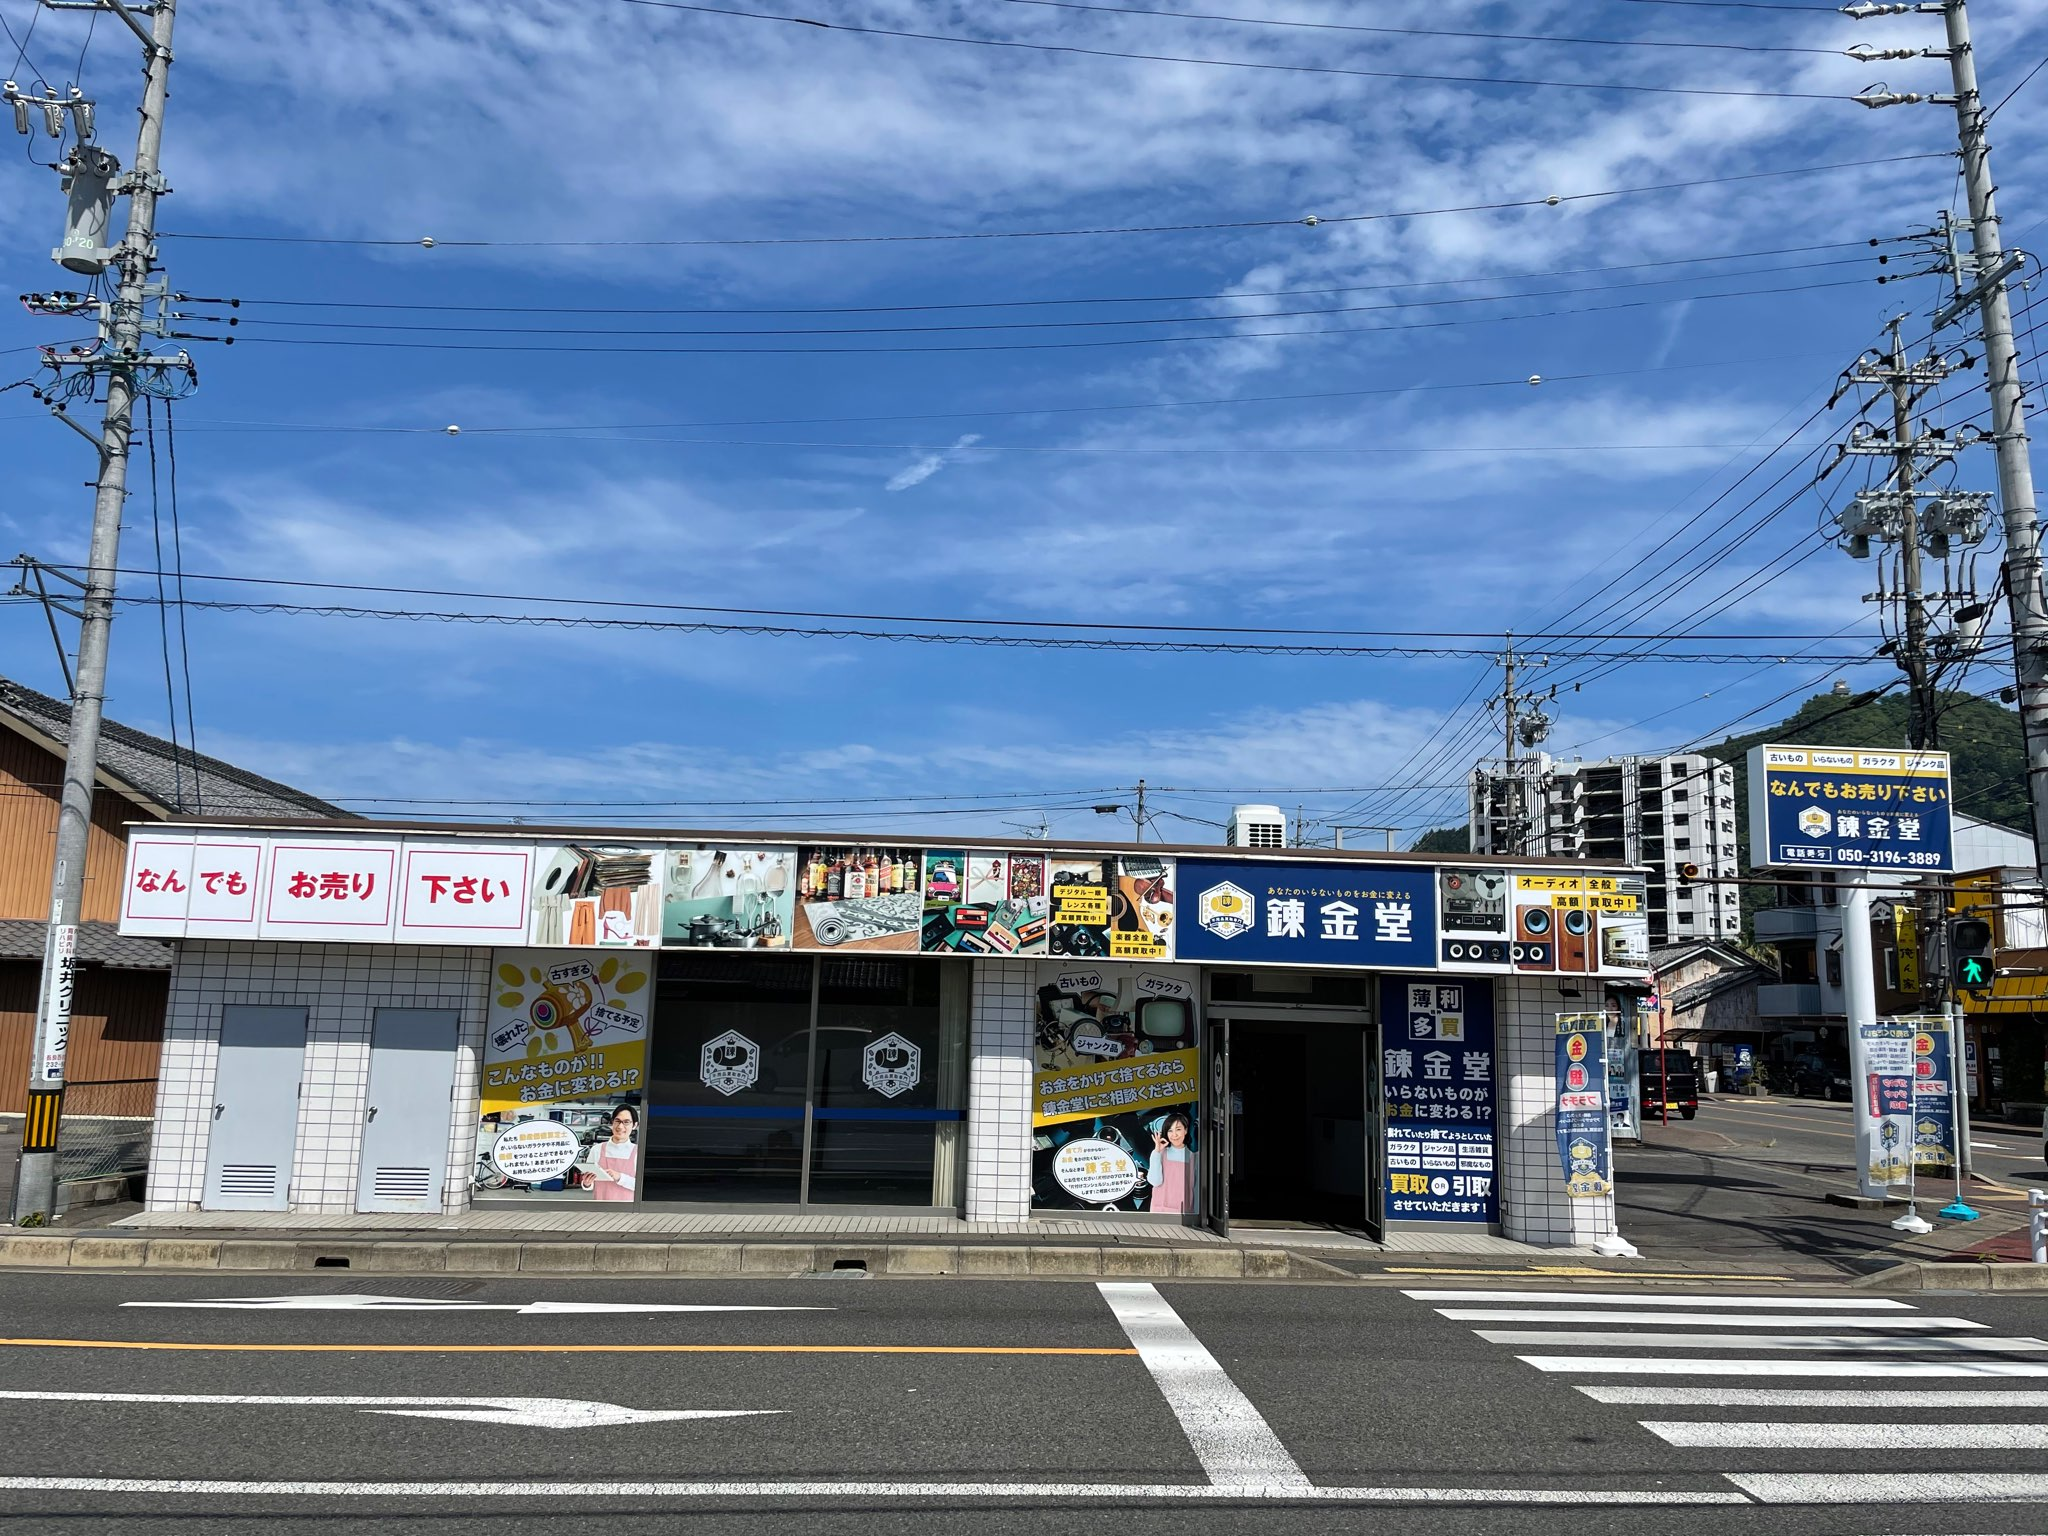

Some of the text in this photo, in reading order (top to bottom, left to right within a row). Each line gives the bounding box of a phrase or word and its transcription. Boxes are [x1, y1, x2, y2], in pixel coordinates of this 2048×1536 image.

[1770, 754, 1945, 769] 古いもの いらないもの ガラクタ ジャンク品
[1770, 780, 1946, 803] なんでもお売り下さい
[1838, 849, 1941, 866] 050-3196-3889
[288, 871, 375, 900] お売り
[421, 875, 510, 904] 下さい
[1059, 888, 1102, 897] デジタル一眼
[1267, 887, 1411, 900] あなたのいらないものをお金に変える
[1067, 902, 1101, 910] レンズ各種
[1061, 914, 1101, 922] 高額買取中!
[1115, 933, 1149, 941] 楽器全般
[1115, 946, 1162, 955] 高額買取中!
[551, 965, 591, 980] 古すぎる
[1059, 976, 1099, 988] 古いもの
[1145, 979, 1182, 994] ガラクタ
[1412, 989, 1459, 1009] 薄利
[595, 1006, 640, 1028] 捨てる予定
[494, 1022, 528, 1047] 壊れた
[1413, 1017, 1460, 1037] 多買
[1077, 1039, 1119, 1053] ジャンク品
[1966, 1044, 1974, 1059] P
[488, 1053, 605, 1086] こんなものが!!
[1040, 1059, 1185, 1096] お金をかけて捨てるなら
[519, 1069, 640, 1103] お金に変わる!?
[1384, 1085, 1488, 1101] いらないものが
[1386, 1103, 1492, 1120] お金に変わる!?
[1424, 1145, 1454, 1153] ジャンク品
[1390, 1158, 1416, 1166] 古いもの
[1390, 1173, 1429, 1195] 買取
[1453, 1176, 1492, 1197] 引取
[1393, 1200, 1486, 1213] させていただきます!
